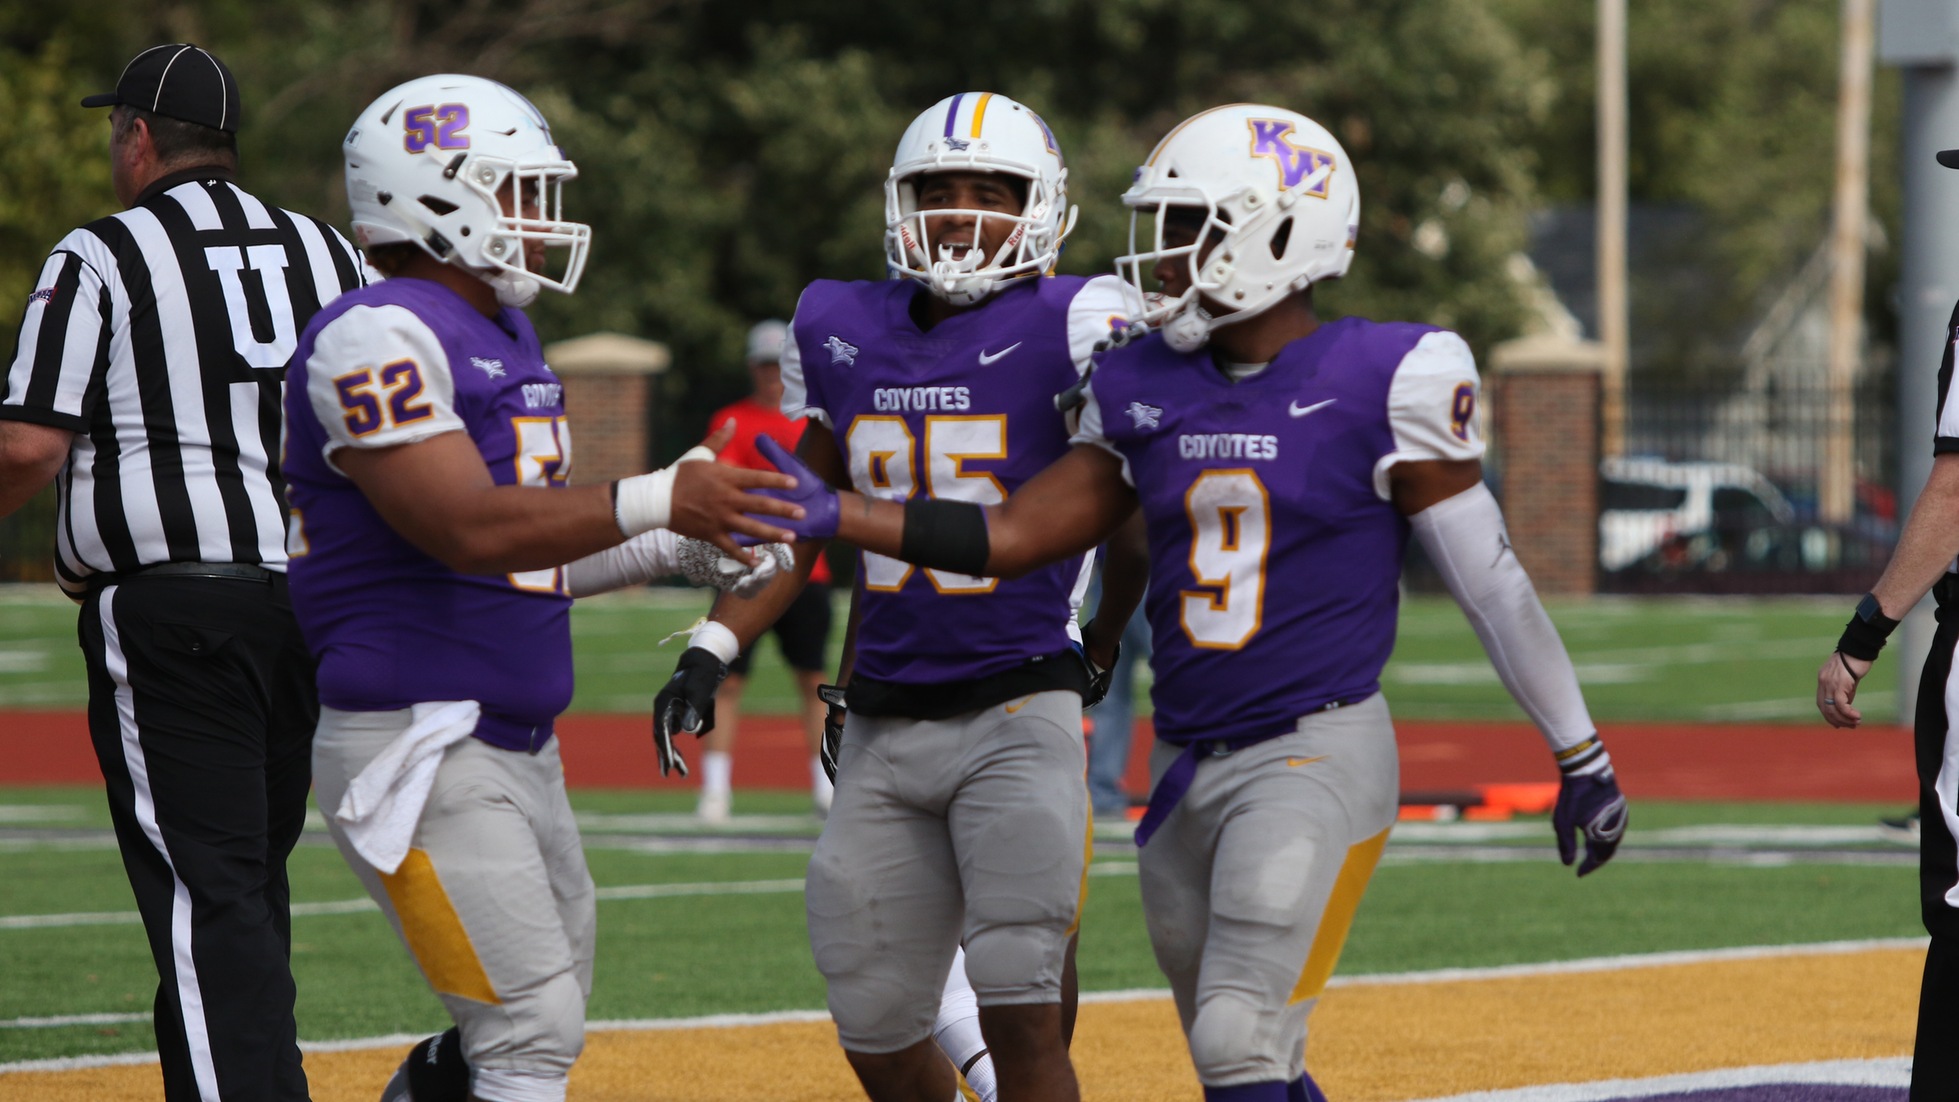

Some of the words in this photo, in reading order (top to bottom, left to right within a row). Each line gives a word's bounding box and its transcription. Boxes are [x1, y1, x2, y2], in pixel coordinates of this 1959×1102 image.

[403, 103, 470, 154] 52
[1246, 117, 1336, 200] KW
[203, 244, 299, 369] U
[332, 357, 434, 438] 52
[874, 386, 971, 412] COYOTES
[1450, 380, 1475, 443] 9
[1179, 433, 1278, 460] COYOTES
[1179, 467, 1272, 651] 9
